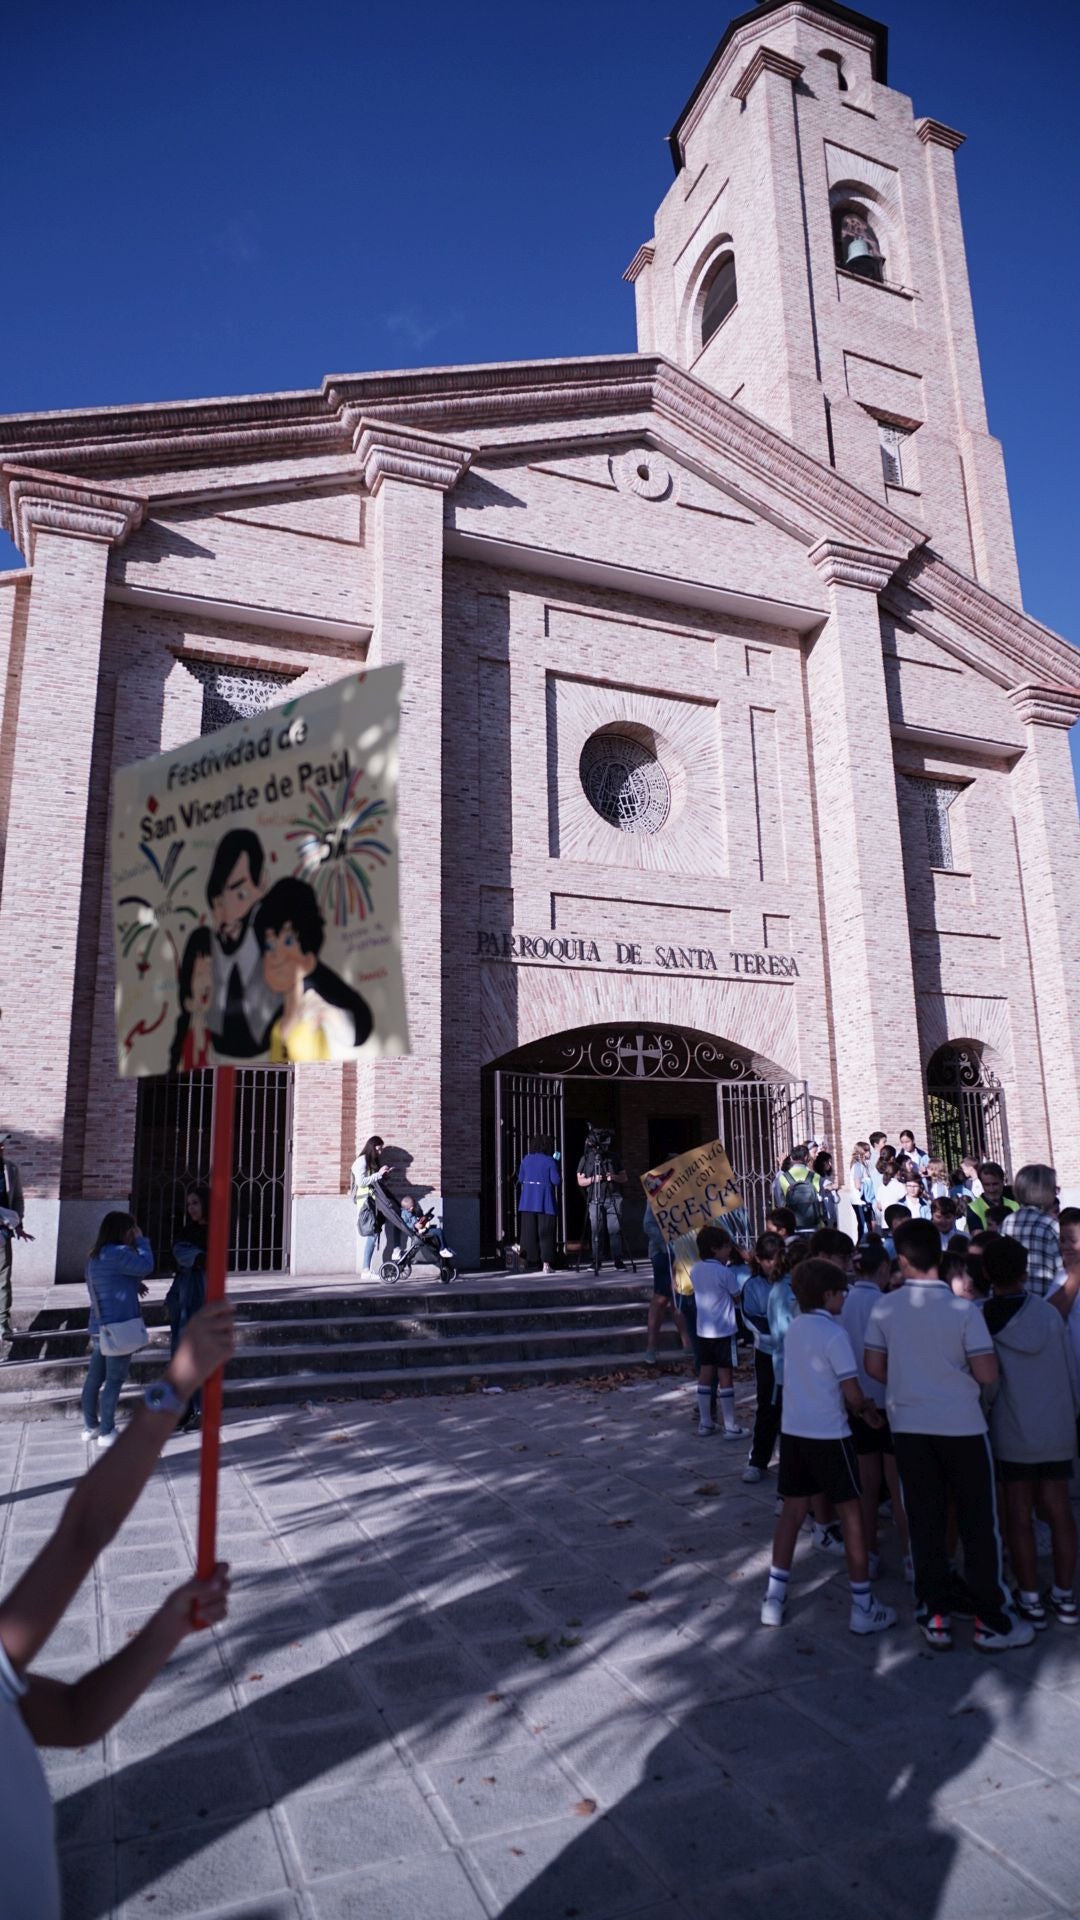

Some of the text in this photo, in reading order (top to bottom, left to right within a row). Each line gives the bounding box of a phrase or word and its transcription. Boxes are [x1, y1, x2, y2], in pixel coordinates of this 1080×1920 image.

[166, 716, 308, 791] Festividad de
[139, 748, 351, 843] San Vicente de Paúl
[477, 930, 801, 977] PARROQUIA DE SANTA TERESA
[696, 1165, 716, 1188] con
